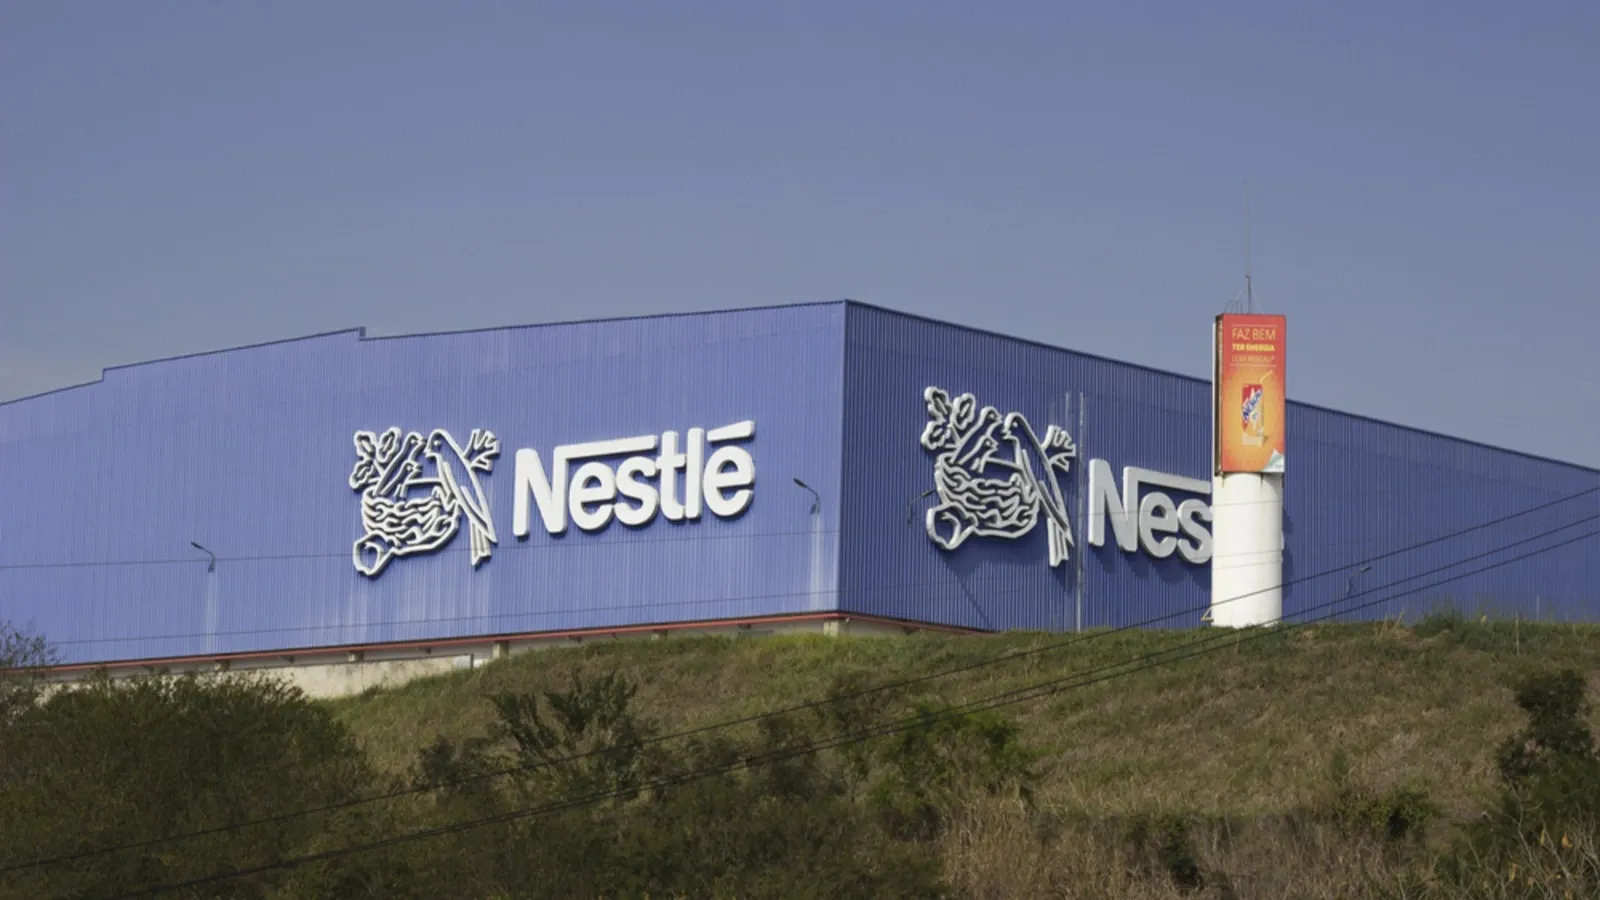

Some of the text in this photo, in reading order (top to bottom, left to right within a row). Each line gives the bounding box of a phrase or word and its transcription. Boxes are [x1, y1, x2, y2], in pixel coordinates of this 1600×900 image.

[1232, 328, 1276, 341] FAZ BEM
[513, 420, 755, 537] Nestlé
[1088, 458, 1213, 564] Nes
